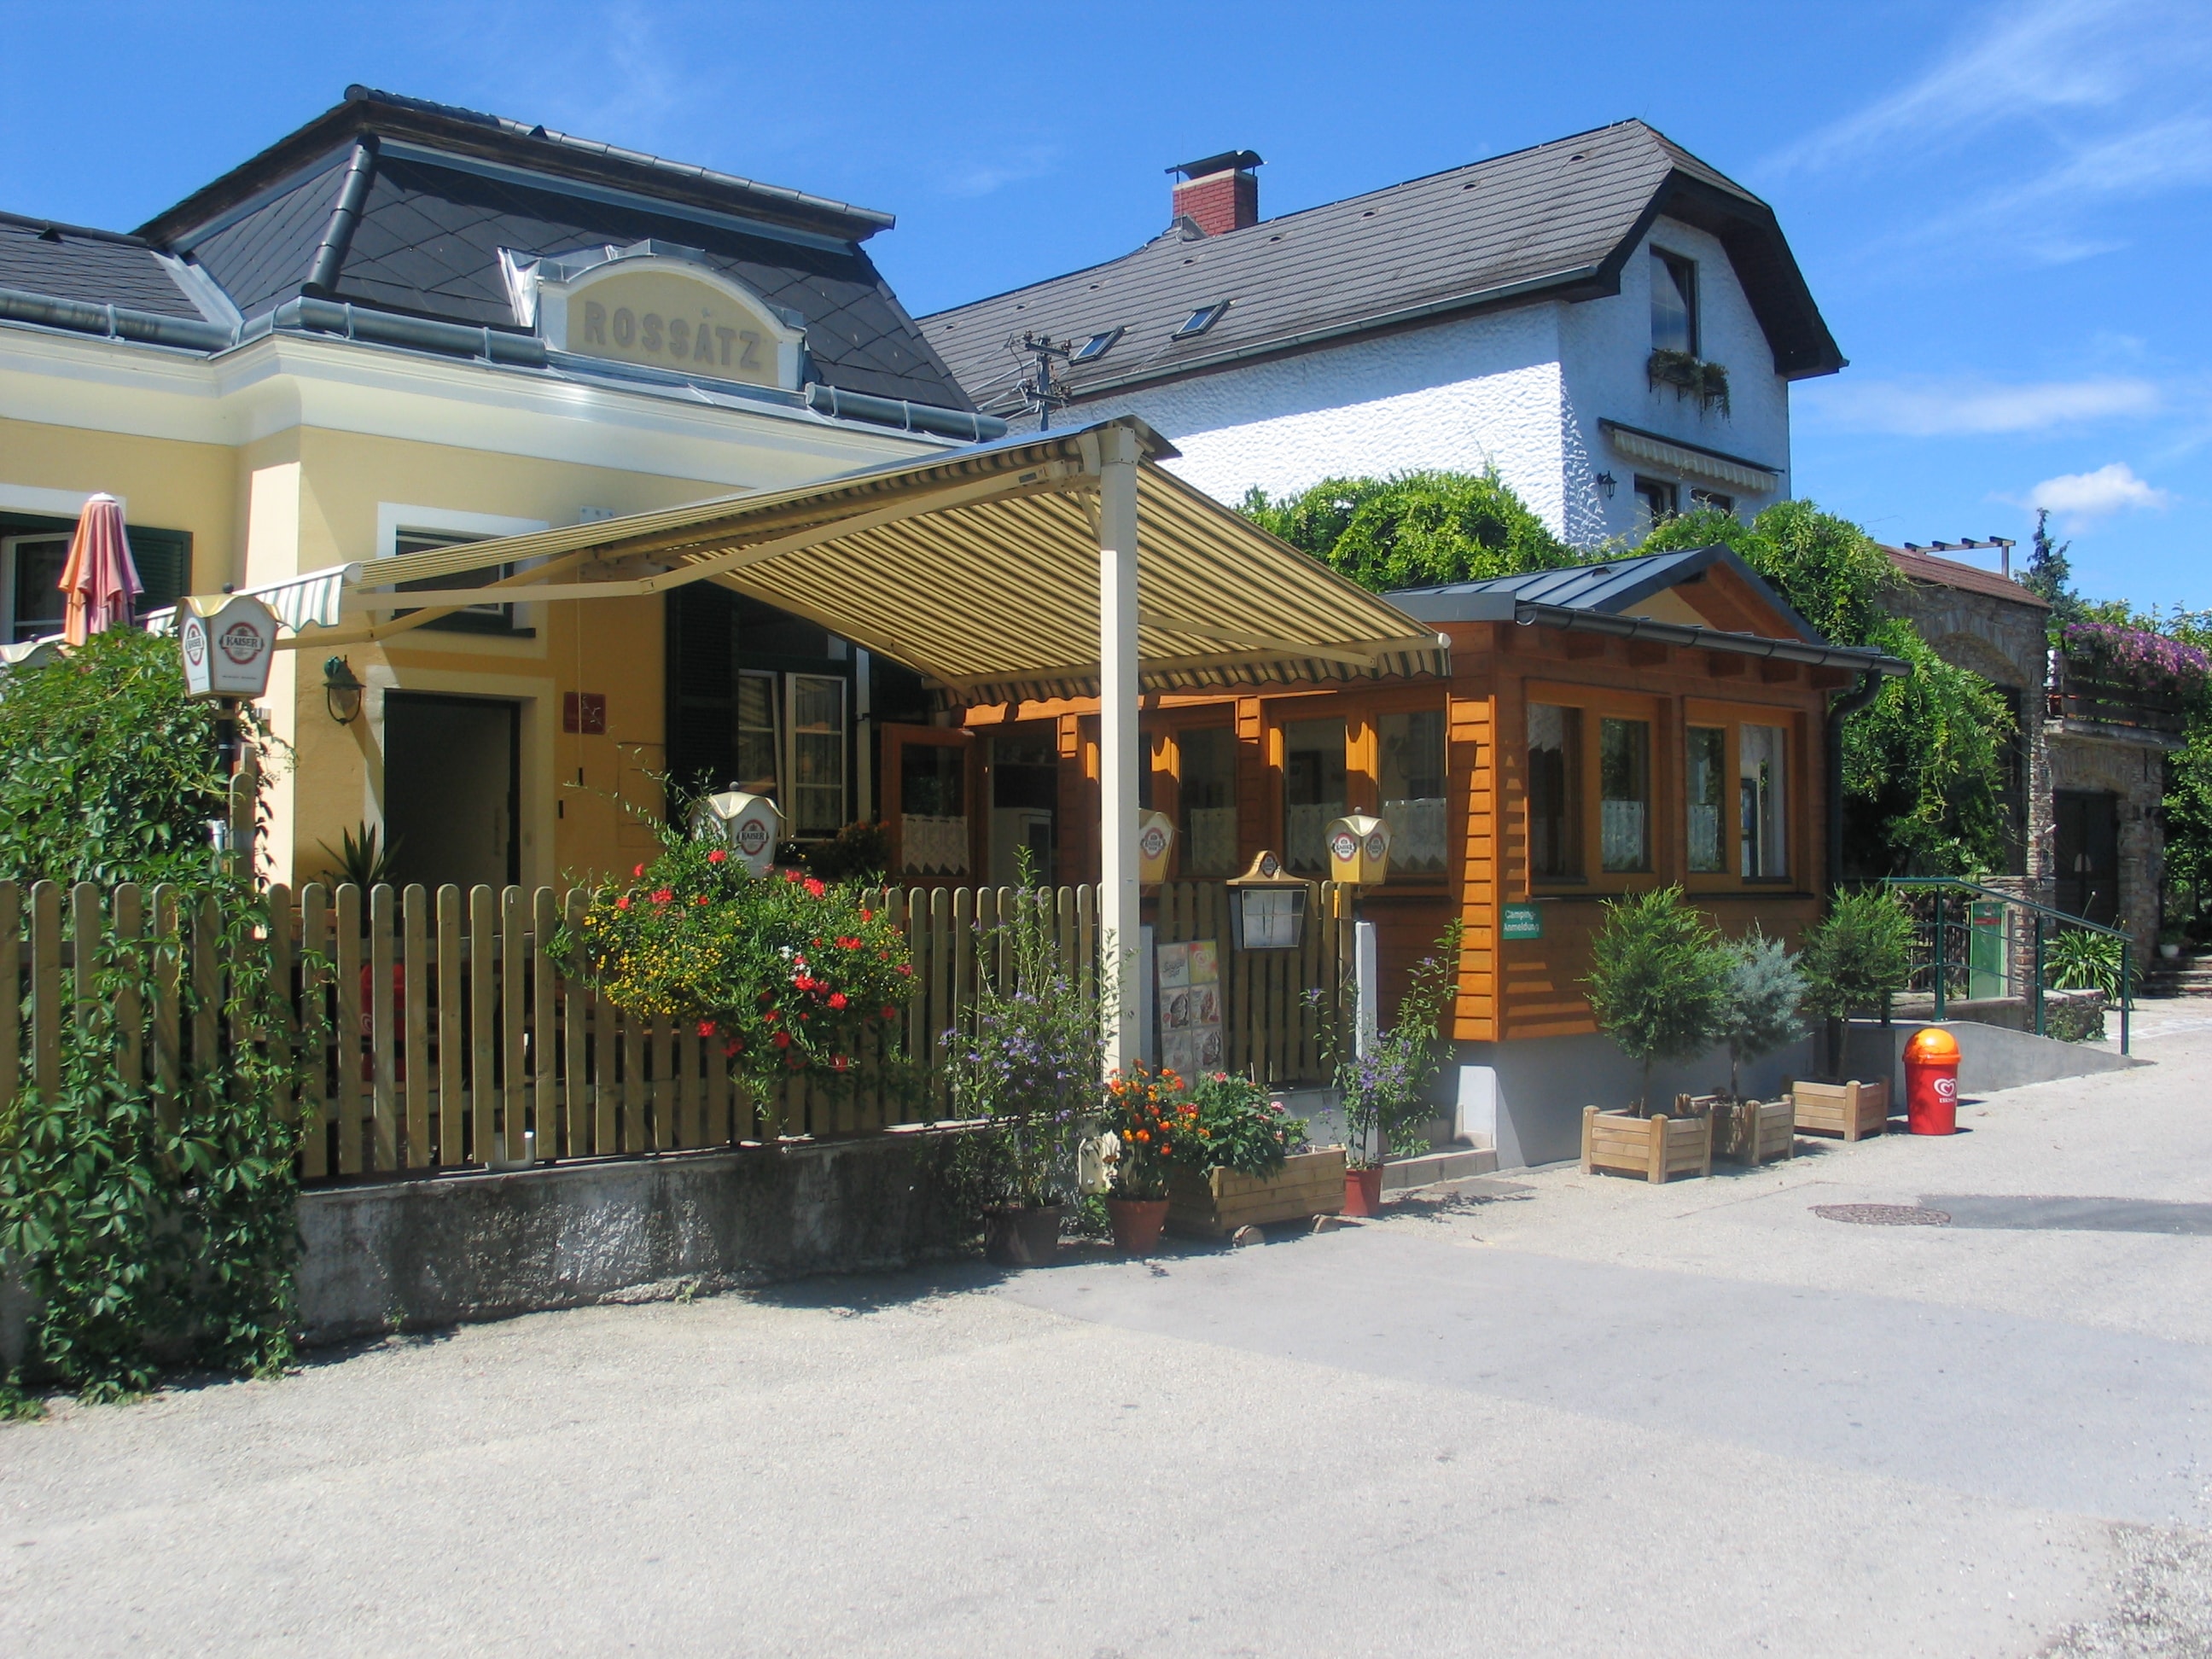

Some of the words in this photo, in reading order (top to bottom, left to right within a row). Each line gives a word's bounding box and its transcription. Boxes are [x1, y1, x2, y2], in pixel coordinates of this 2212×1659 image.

[226, 637, 258, 648] KAISER
[742, 832, 765, 841] KAISER
[1503, 923, 1540, 932] Anmeldung
